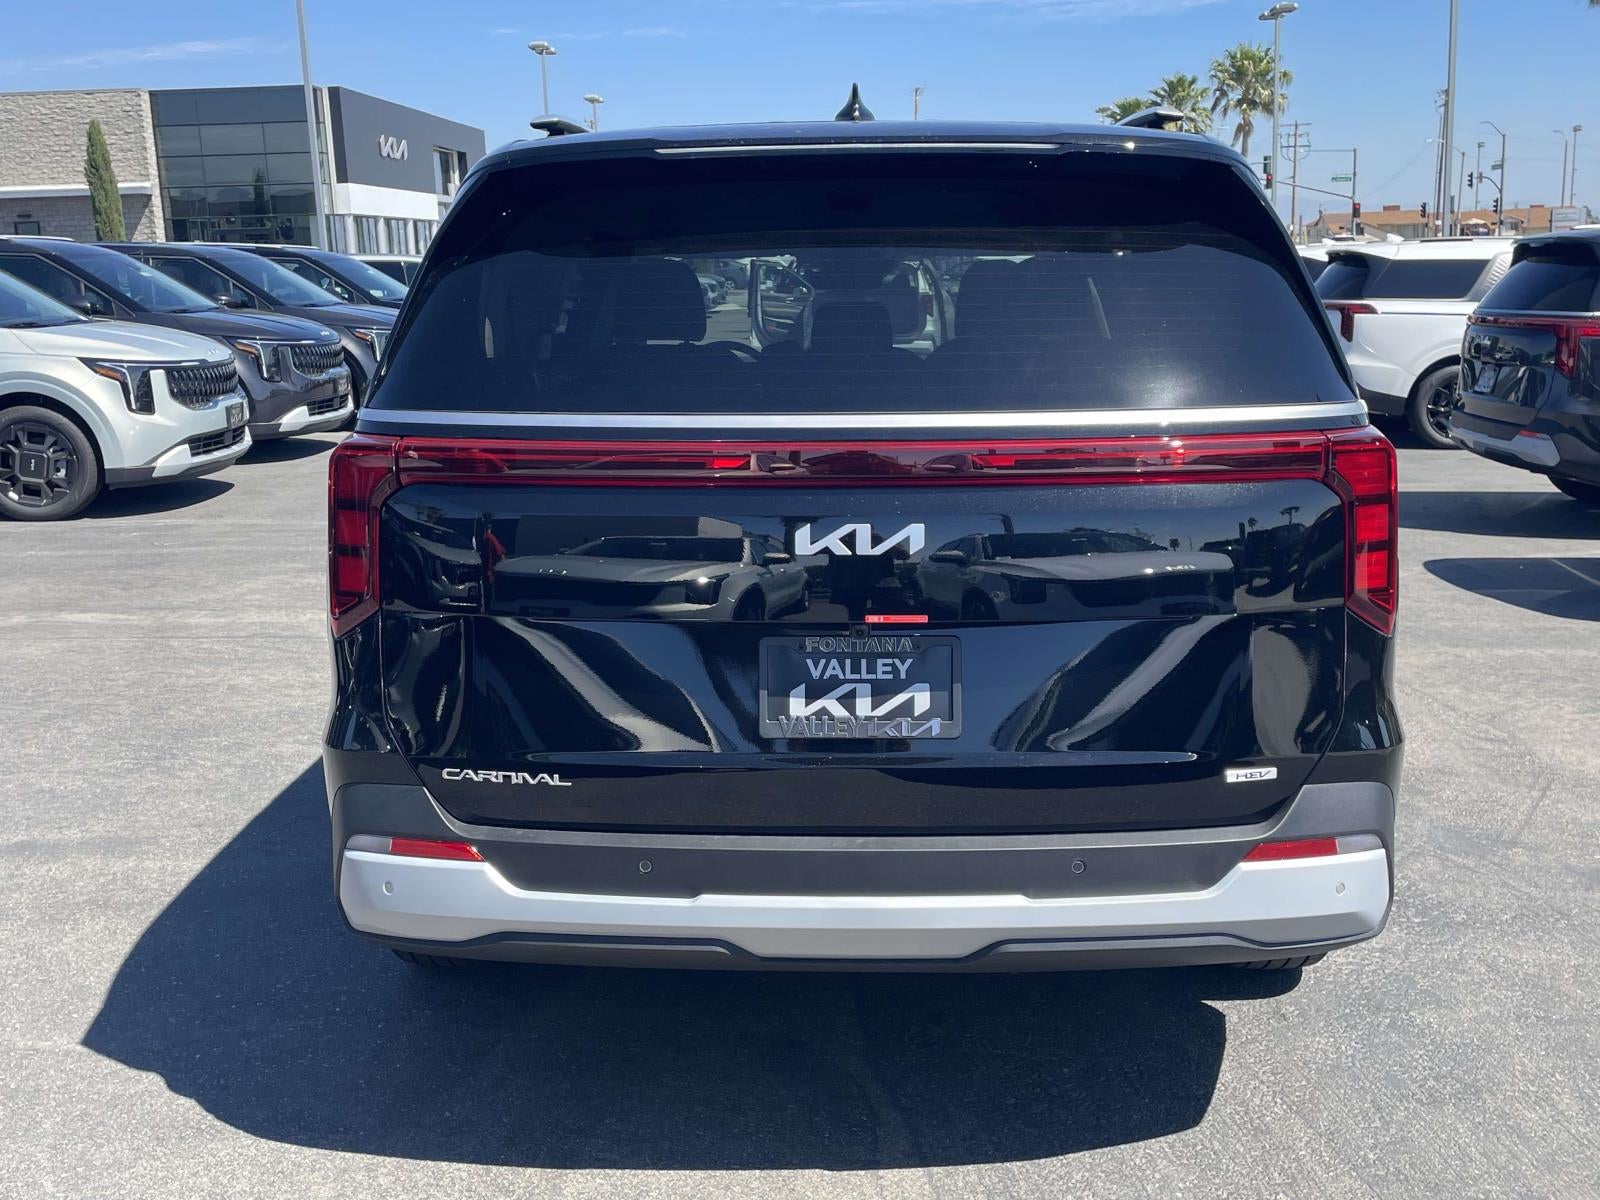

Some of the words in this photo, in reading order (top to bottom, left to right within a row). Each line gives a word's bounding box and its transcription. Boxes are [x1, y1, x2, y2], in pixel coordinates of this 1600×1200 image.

[795, 523, 925, 555] KIA
[805, 636, 914, 653] FONTANA
[806, 658, 914, 680] VALLEY
[789, 682, 931, 717] KIA
[778, 715, 865, 738] VALLEY
[867, 717, 942, 737] KIA
[441, 767, 572, 787] CARNIVAL
[1235, 769, 1272, 780] HEV
